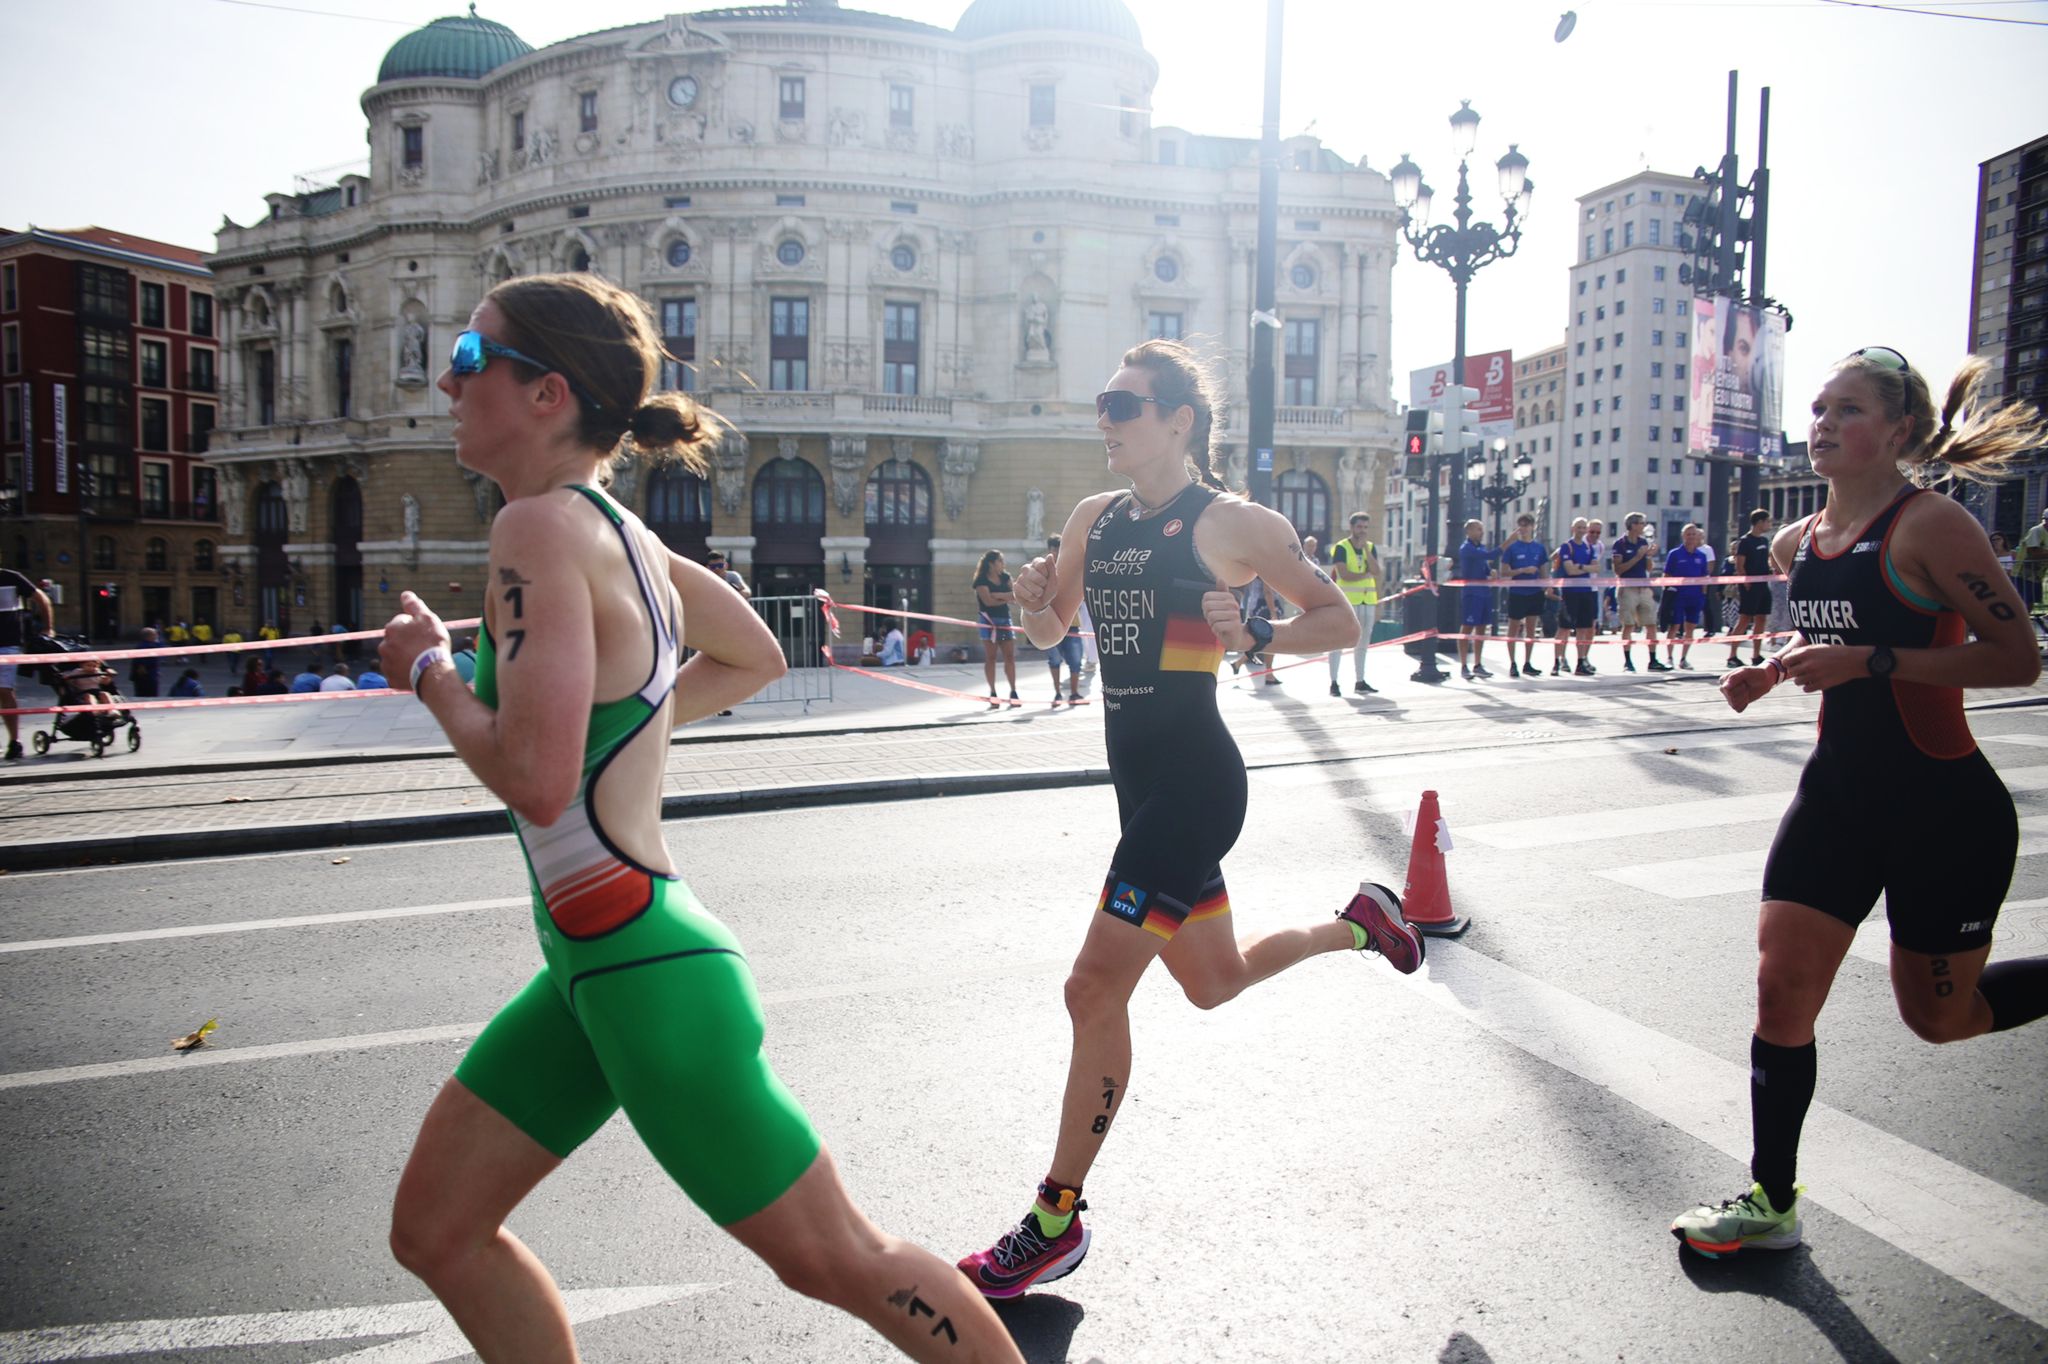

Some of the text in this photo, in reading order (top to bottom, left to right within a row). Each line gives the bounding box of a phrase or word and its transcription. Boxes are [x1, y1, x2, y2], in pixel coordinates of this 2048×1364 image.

[1090, 560, 1146, 576] SPORTS
[1113, 548, 1152, 562] ultra
[1085, 586, 1155, 620] THEISEN
[1789, 599, 1860, 630] DEKKER
[1968, 580, 2016, 621] 20
[503, 585, 526, 662] 17
[1098, 622, 1141, 656] GER
[1113, 900, 1136, 915] DTU
[1931, 958, 1953, 998] 20
[1091, 1088, 1115, 1134] 18
[909, 1296, 958, 1345] 17
